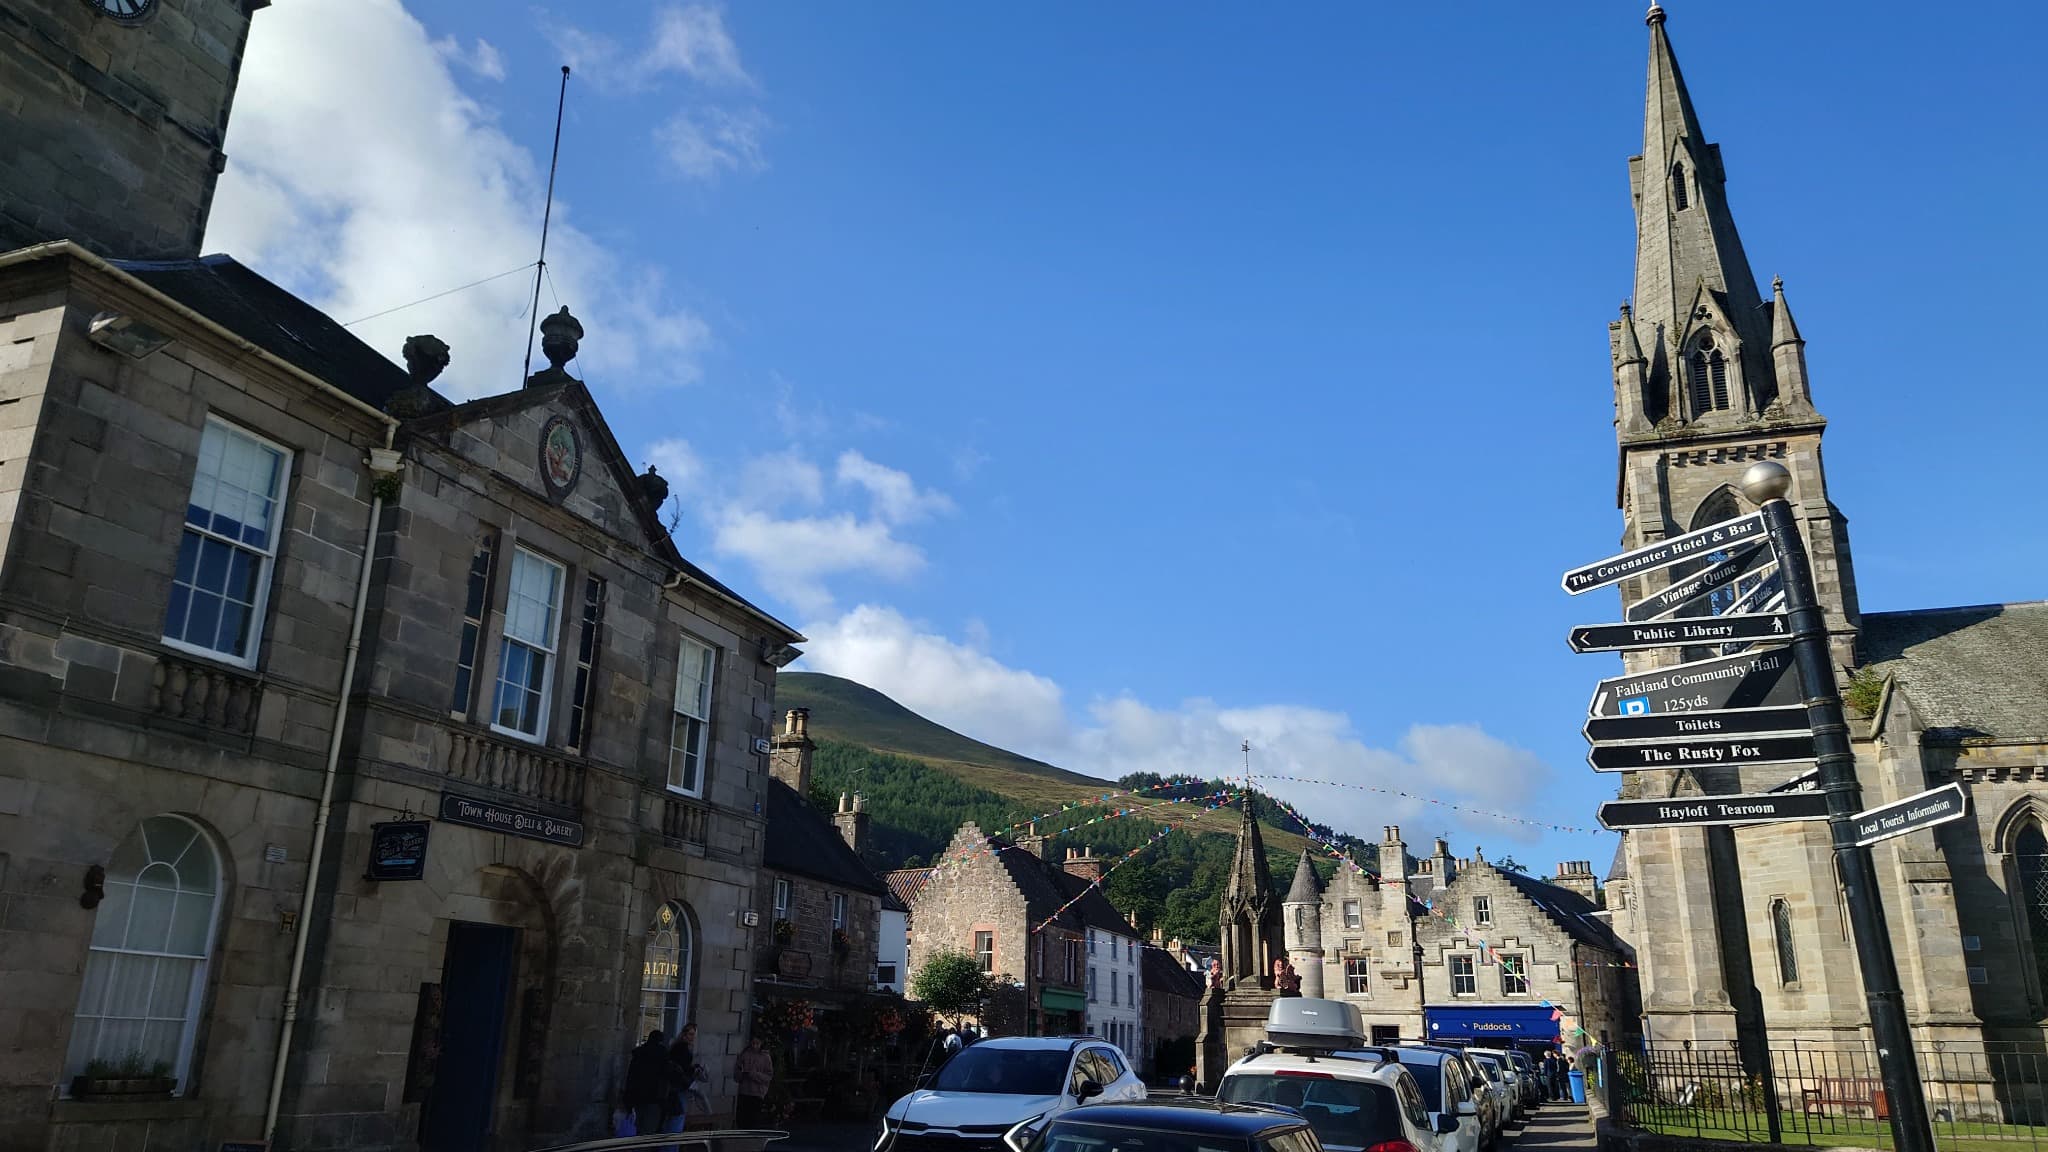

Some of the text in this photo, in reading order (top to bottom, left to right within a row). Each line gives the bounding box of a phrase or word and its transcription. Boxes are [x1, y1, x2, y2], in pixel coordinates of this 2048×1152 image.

[1570, 522, 1753, 587] The Covenanter Hotel & Bar
[1659, 563, 1738, 605] Vintage Quine
[1633, 625, 1733, 641] Public Library
[1615, 656, 1780, 697] Falkland Community Hall
[1663, 694, 1709, 712] 125yds
[1675, 719, 1721, 731] Toilets
[1640, 744, 1761, 761] The Rusty Fox
[1658, 803, 1775, 820] Hayloft Tearoom
[1860, 800, 1950, 835] Local Tourist Information
[536, 821, 542, 831] &
[1473, 1022, 1513, 1031] Puddocks
